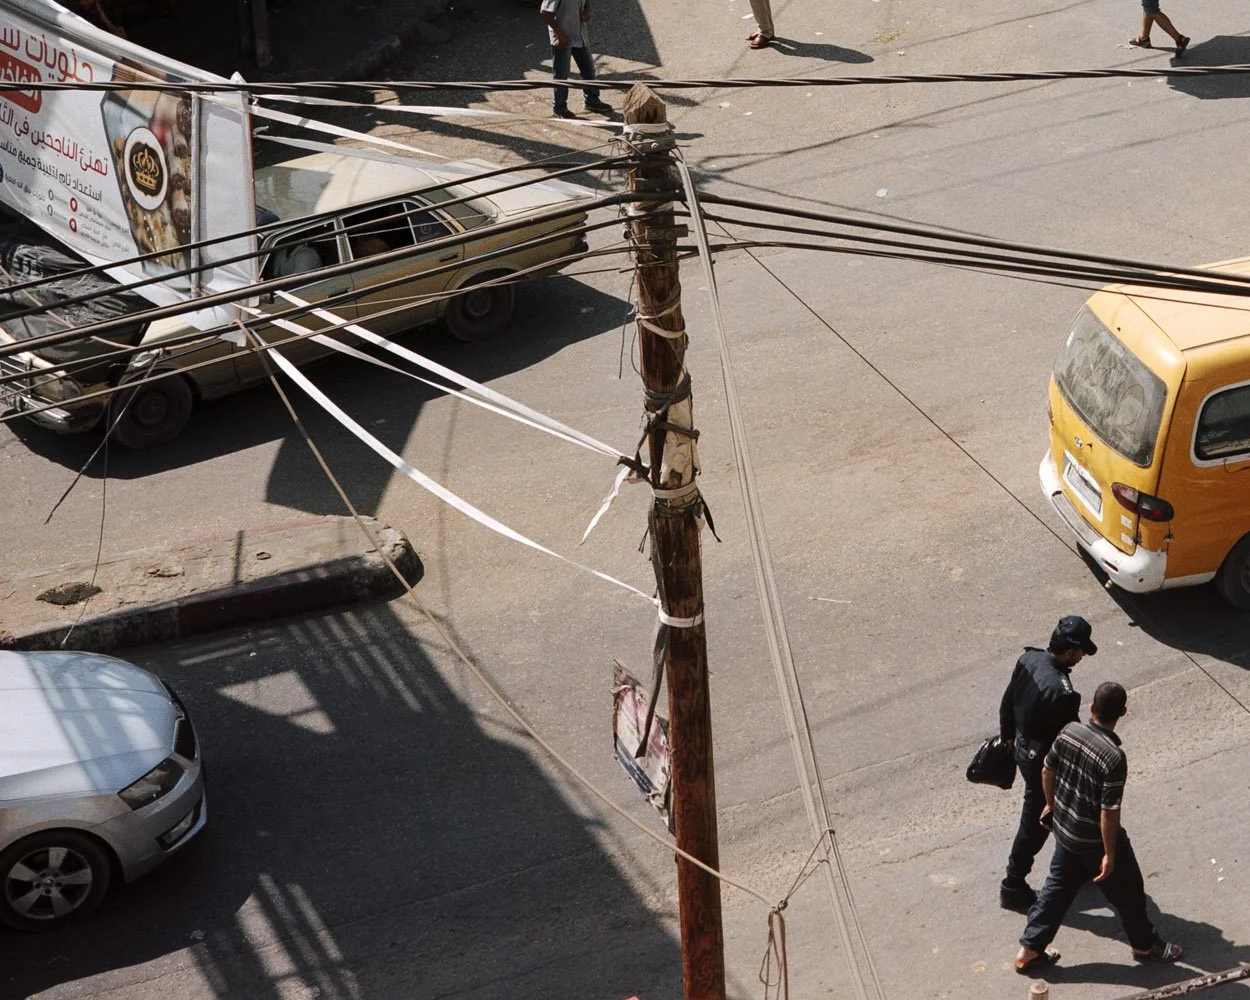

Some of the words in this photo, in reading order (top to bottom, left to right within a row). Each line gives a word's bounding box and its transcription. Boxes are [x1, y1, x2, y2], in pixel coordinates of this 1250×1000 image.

[25, 33, 94, 86] حلويات
[14, 116, 30, 142] في
[31, 129, 78, 163] الناجحين
[17, 149, 37, 171] جميع
[79, 147, 109, 177] تهنئ
[58, 173, 72, 188] تام
[72, 179, 103, 203] استعداد
